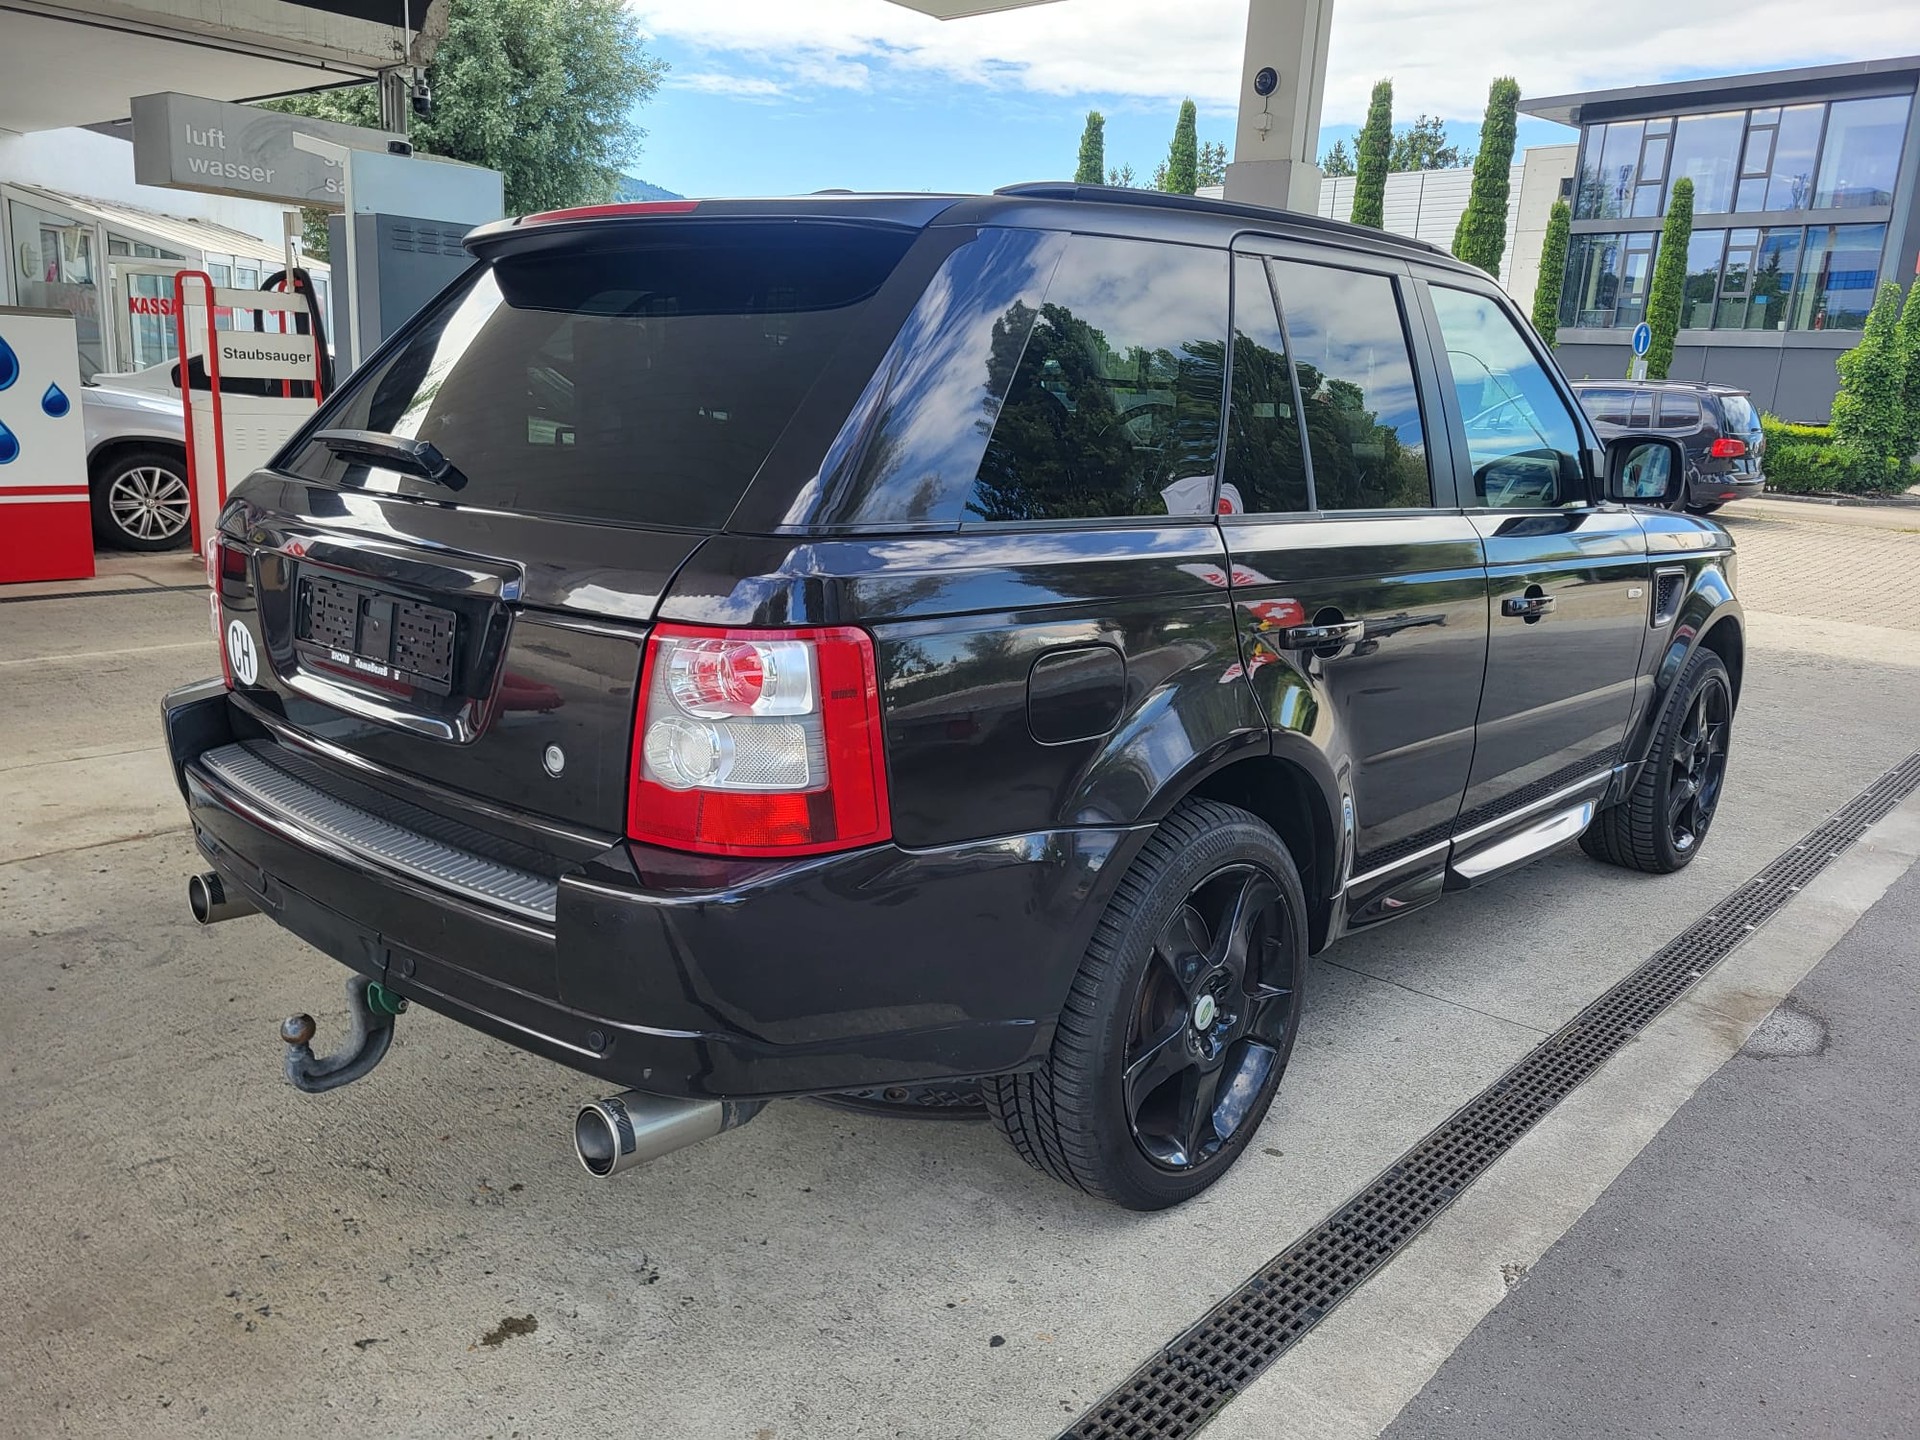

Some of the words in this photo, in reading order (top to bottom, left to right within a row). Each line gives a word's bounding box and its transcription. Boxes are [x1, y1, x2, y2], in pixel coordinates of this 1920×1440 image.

[185, 124, 226, 150] luft
[188, 157, 276, 184] wasser
[223, 347, 312, 364] Staubsauger
[231, 625, 253, 680] CH
